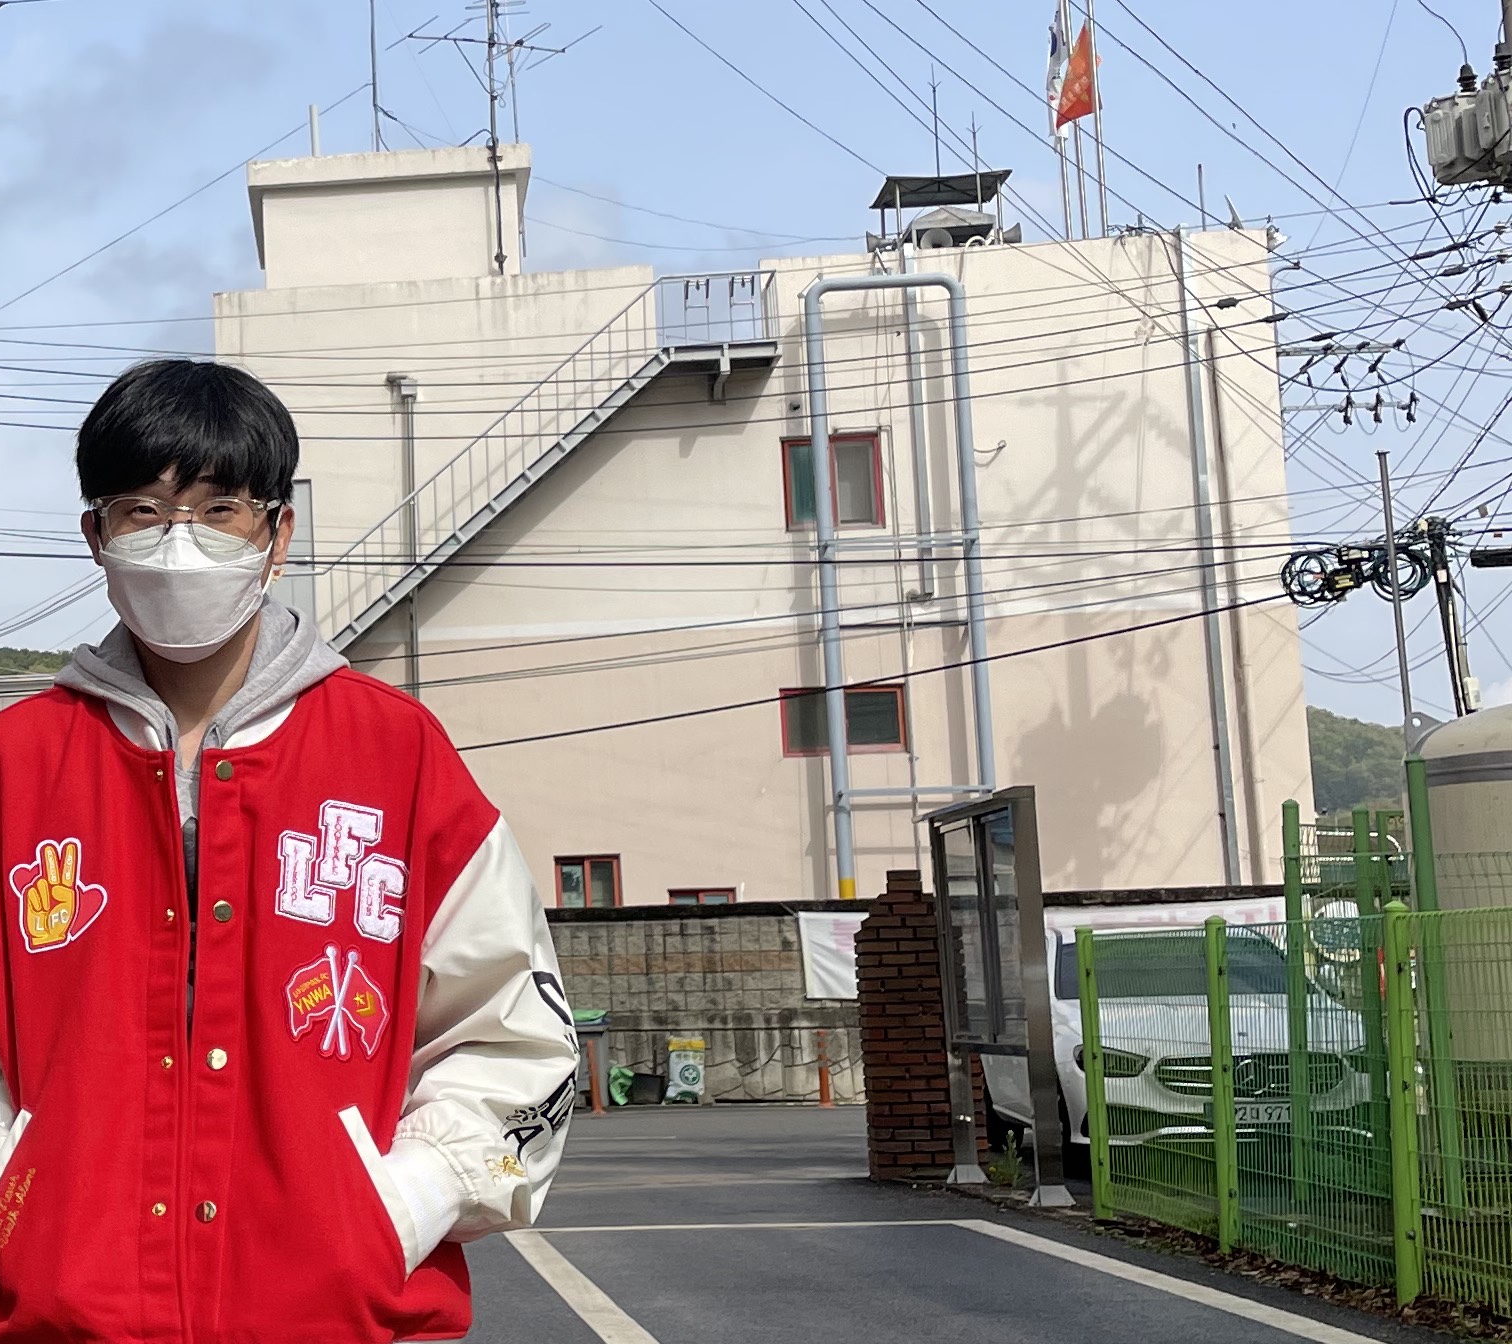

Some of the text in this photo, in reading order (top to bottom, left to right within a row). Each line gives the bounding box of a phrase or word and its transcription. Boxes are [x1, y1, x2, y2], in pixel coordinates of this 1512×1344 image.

[275, 799, 409, 944] LFC
[35, 909, 68, 931] LFC
[293, 983, 333, 1015] YNWA
